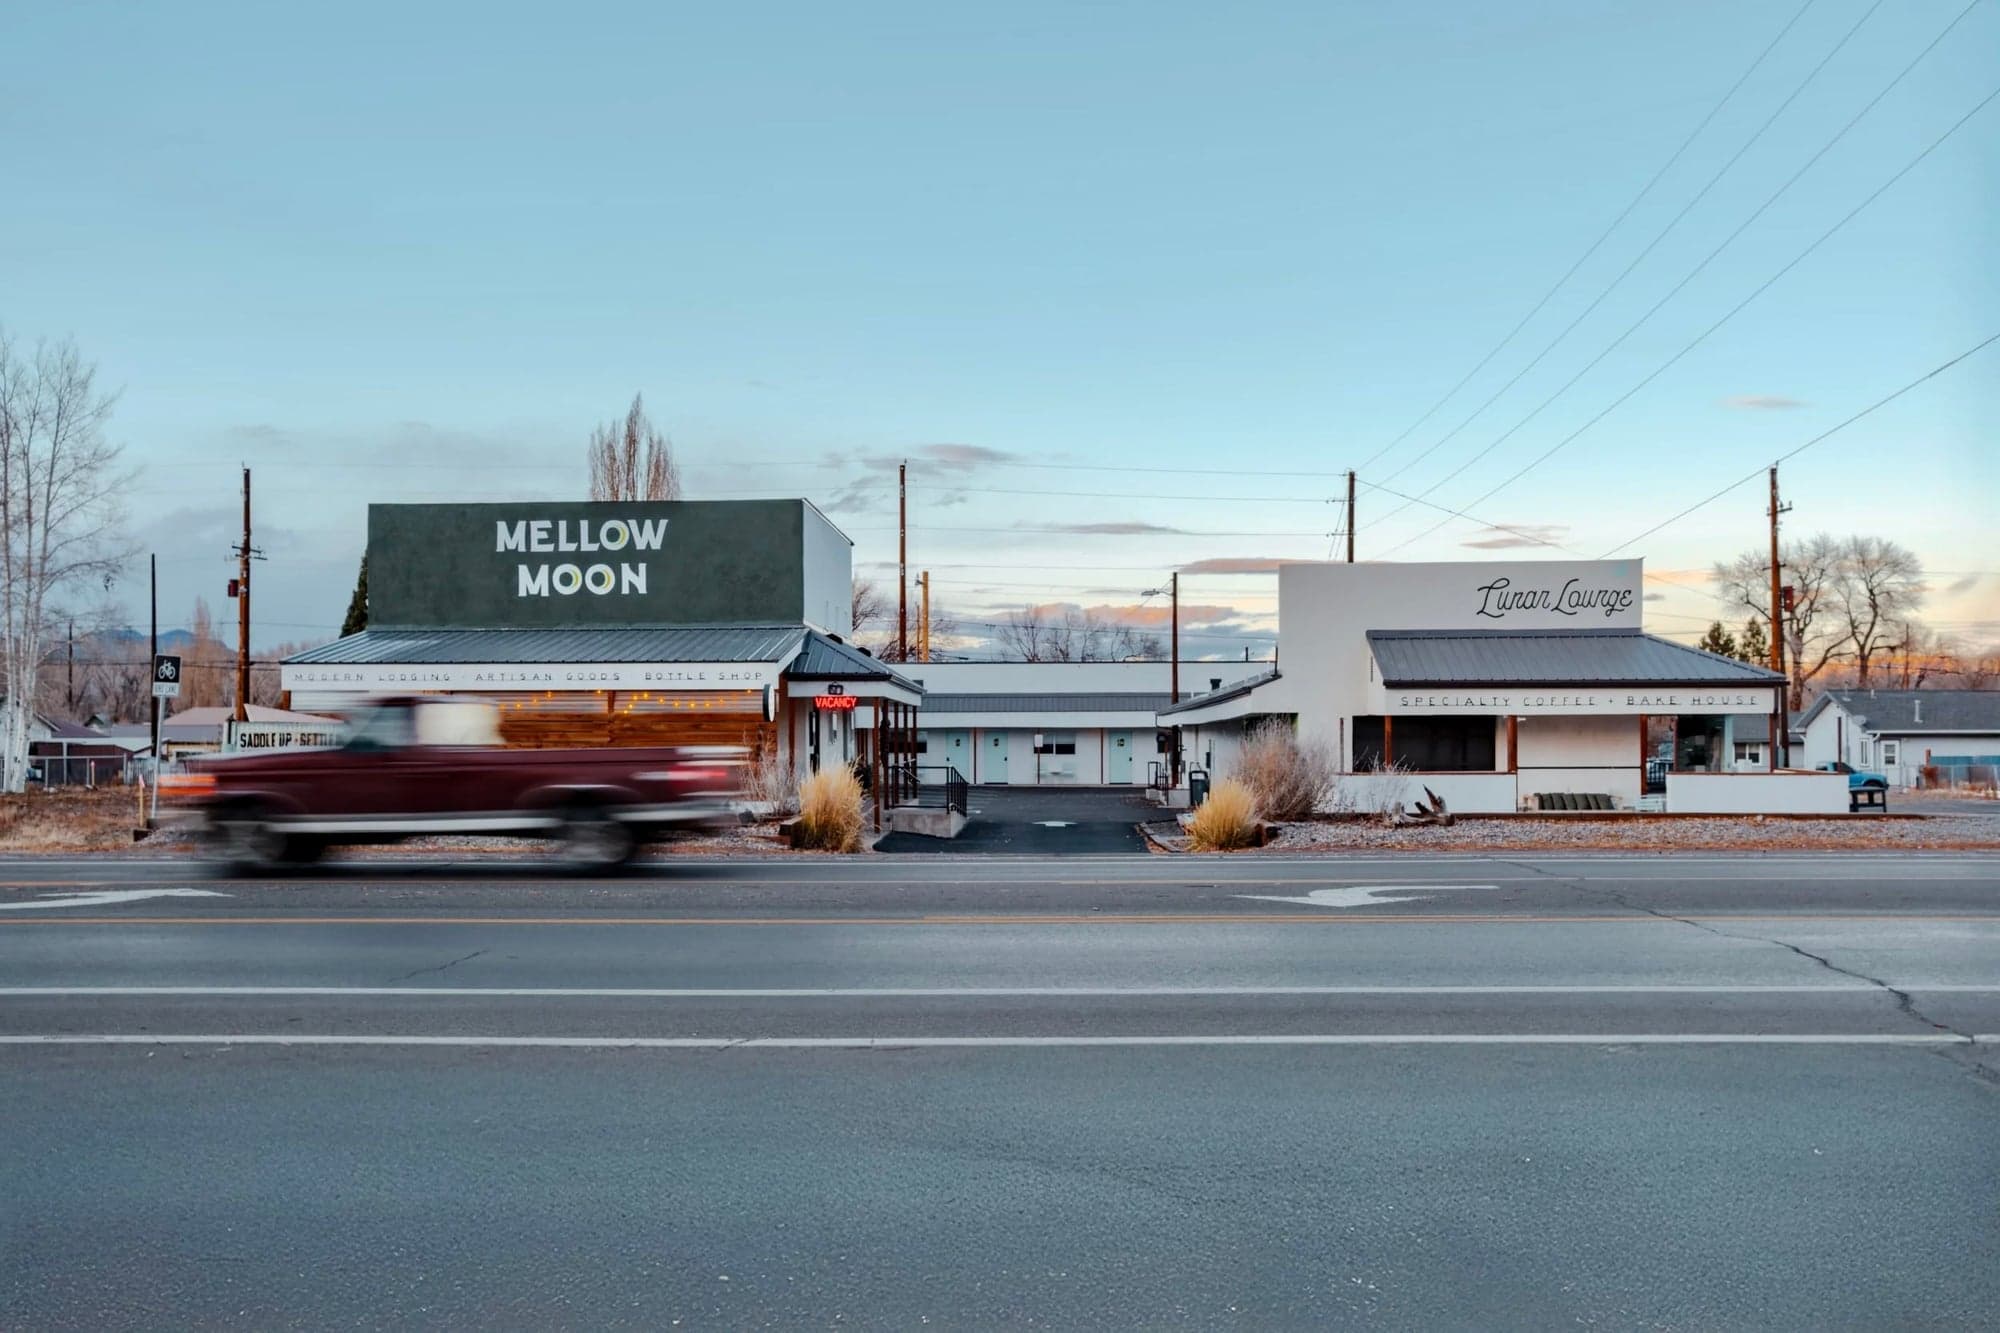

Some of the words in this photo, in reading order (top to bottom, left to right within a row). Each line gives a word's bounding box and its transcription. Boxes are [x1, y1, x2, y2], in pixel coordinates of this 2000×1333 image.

[496, 519, 669, 552] MELLOW
[518, 563, 648, 597] MOON
[1476, 577, 1550, 618] Lunar
[1550, 578, 1633, 617] Lounge
[294, 673, 364, 681] MODERN
[378, 673, 451, 681] LODGING
[475, 672, 552, 681] ARTISAN
[566, 672, 620, 681] GOODS
[644, 672, 706, 681] BOTTLE
[718, 671, 762, 681] SHOP
[815, 696, 857, 708] VACANCY
[1400, 696, 1511, 706] SPECIALTY
[1523, 696, 1596, 706] COFFEE
[1626, 695, 1677, 706] BAKE
[1692, 695, 1757, 706] HOUSE
[240, 732, 276, 748] SADDLE
[279, 732, 292, 747] UP
